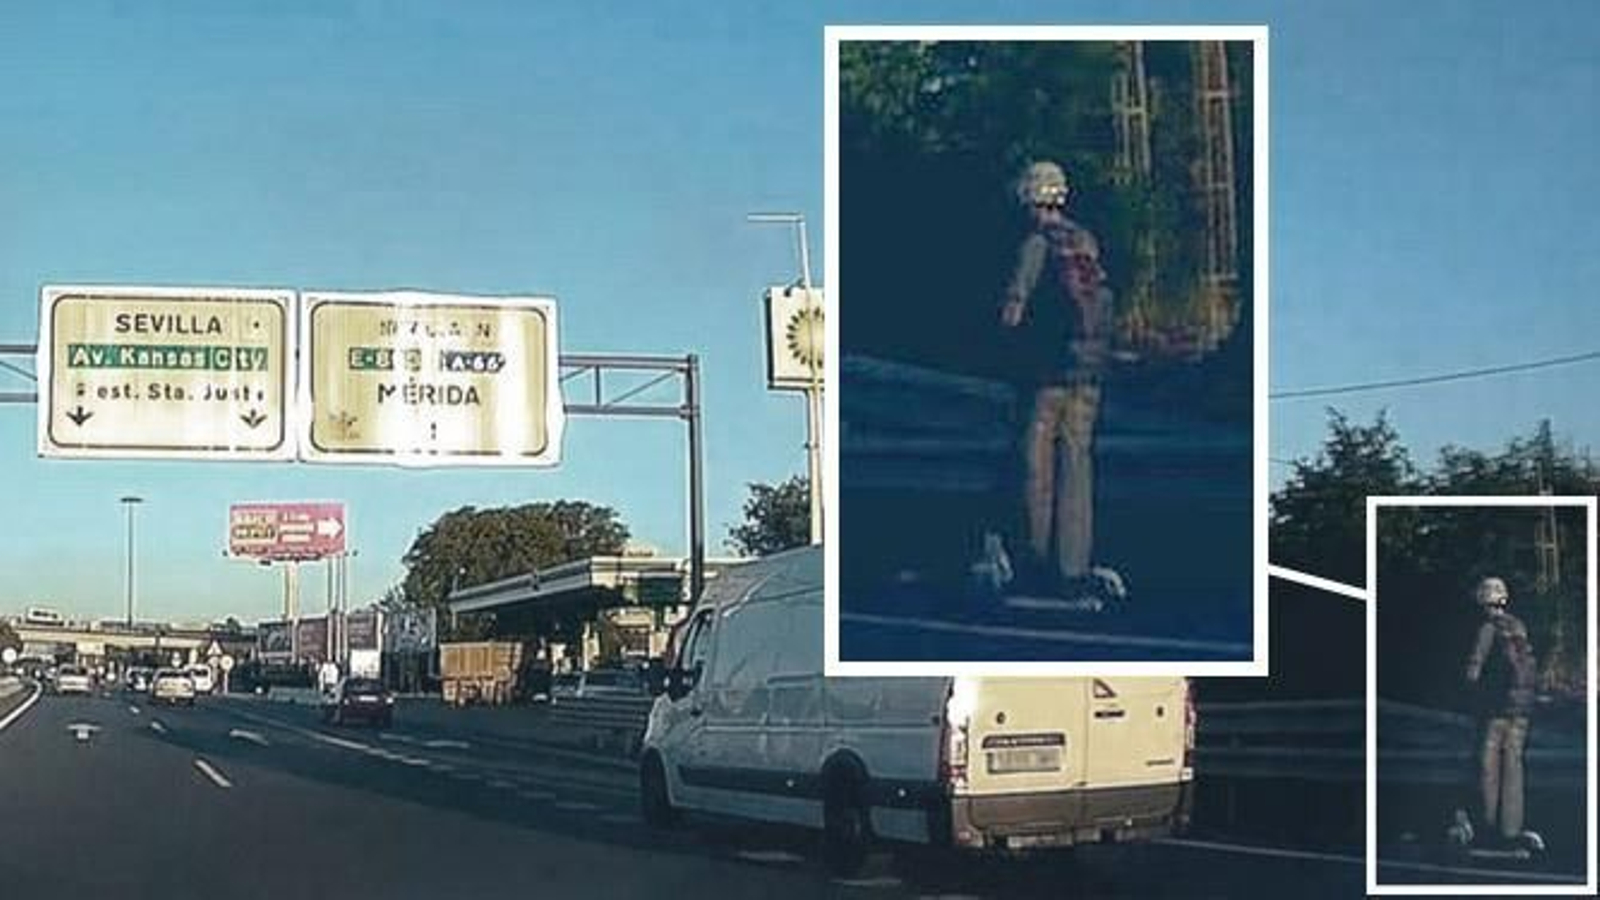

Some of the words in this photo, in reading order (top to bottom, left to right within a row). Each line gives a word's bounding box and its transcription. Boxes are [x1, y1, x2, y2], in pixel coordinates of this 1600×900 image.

[115, 313, 222, 335] SEVILLA
[72, 346, 112, 366] Av.
[120, 346, 206, 368] Kansas
